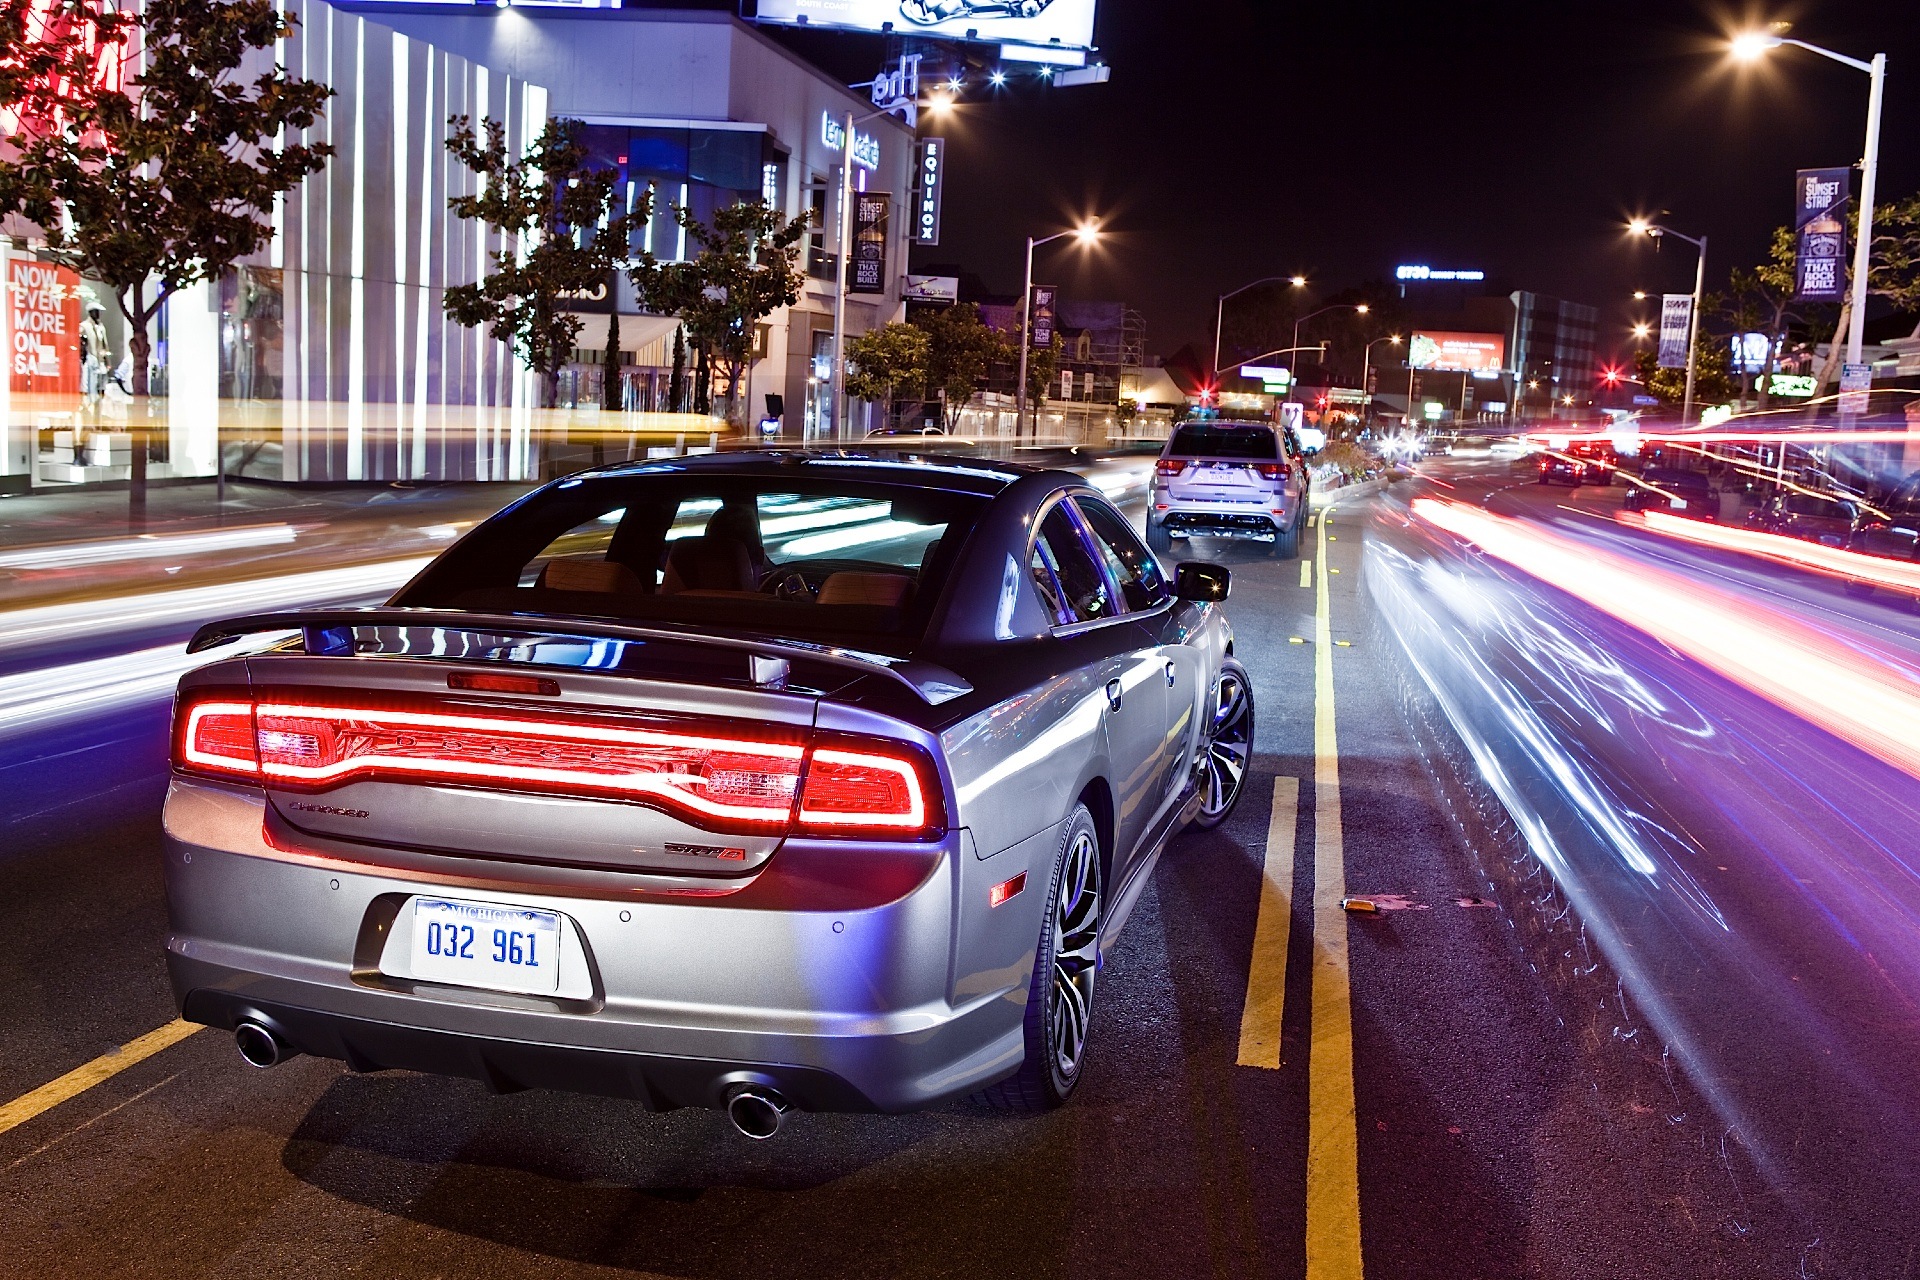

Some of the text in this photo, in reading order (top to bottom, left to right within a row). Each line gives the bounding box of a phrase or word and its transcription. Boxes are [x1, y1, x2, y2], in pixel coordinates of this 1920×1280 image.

[922, 143, 937, 239] EQUINOX
[1806, 182, 1839, 196] SUNSET
[860, 202, 884, 213] SUNSET
[1806, 196, 1832, 209] STRIP
[859, 212, 878, 222] STRIP
[857, 270, 878, 278] ROCK
[858, 263, 879, 271] THAT
[1805, 263, 1835, 272] THAT
[14, 264, 58, 288] NOW
[1805, 272, 1835, 281] ROCK
[14, 288, 62, 312] EVEN
[14, 310, 66, 335] MORE
[14, 331, 41, 354] ON
[289, 801, 370, 819] CHARGER
[450, 904, 522, 922] MICHIGAN
[427, 921, 540, 967] 032 961
